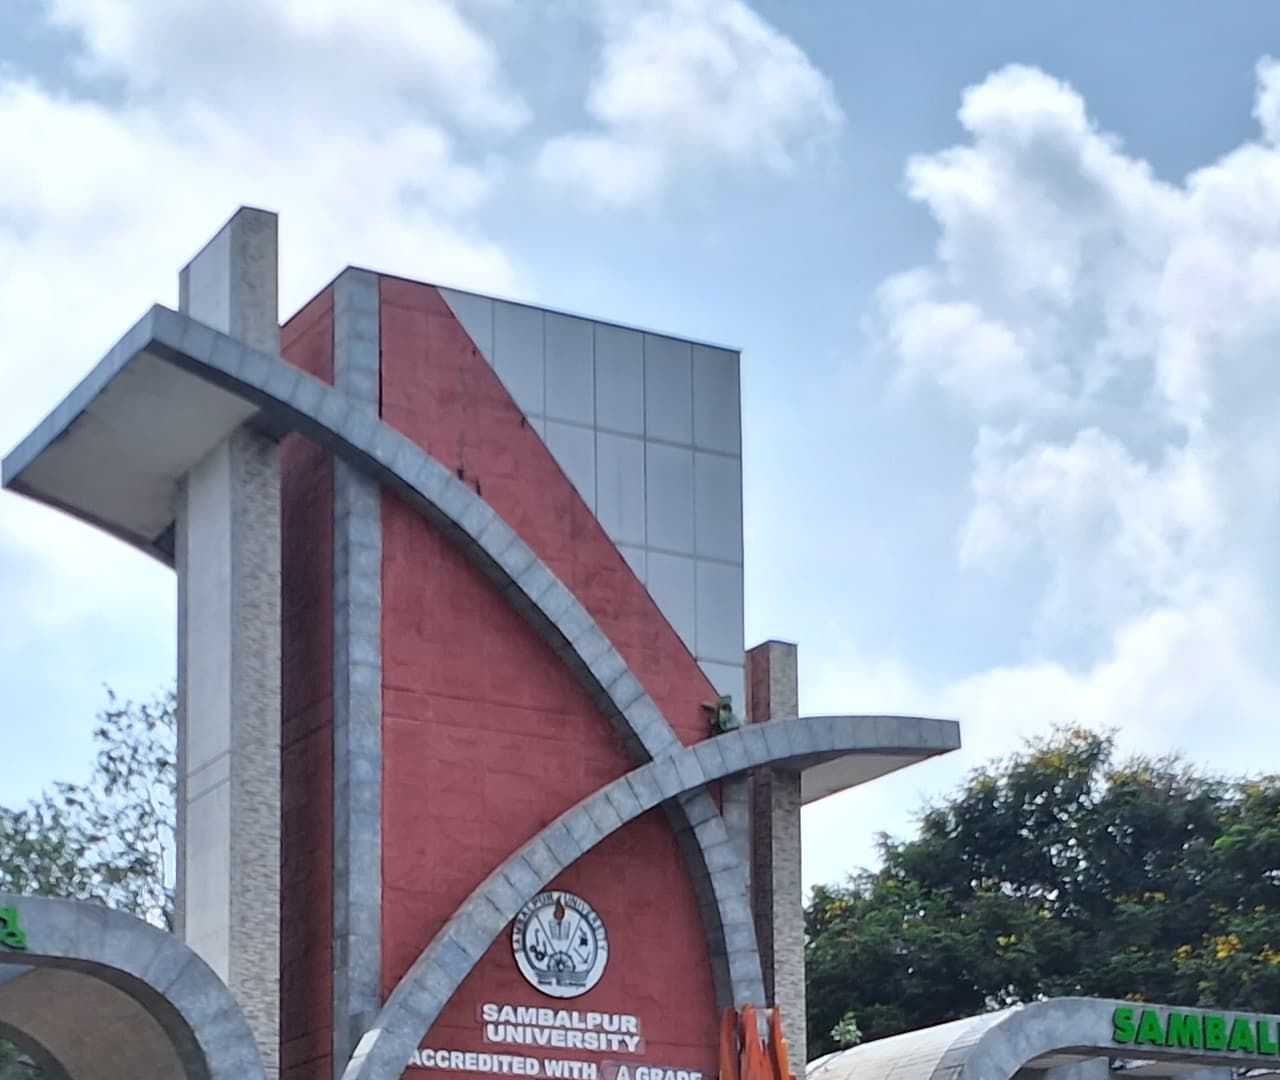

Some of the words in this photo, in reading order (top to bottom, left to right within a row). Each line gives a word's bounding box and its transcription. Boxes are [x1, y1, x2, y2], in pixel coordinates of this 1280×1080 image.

[483, 1003, 638, 1033] SAMBALPUR
[486, 1025, 641, 1053] UNIVERSITY
[408, 1048, 540, 1076] ACCREDITED
[544, 1059, 598, 1080] WITH
